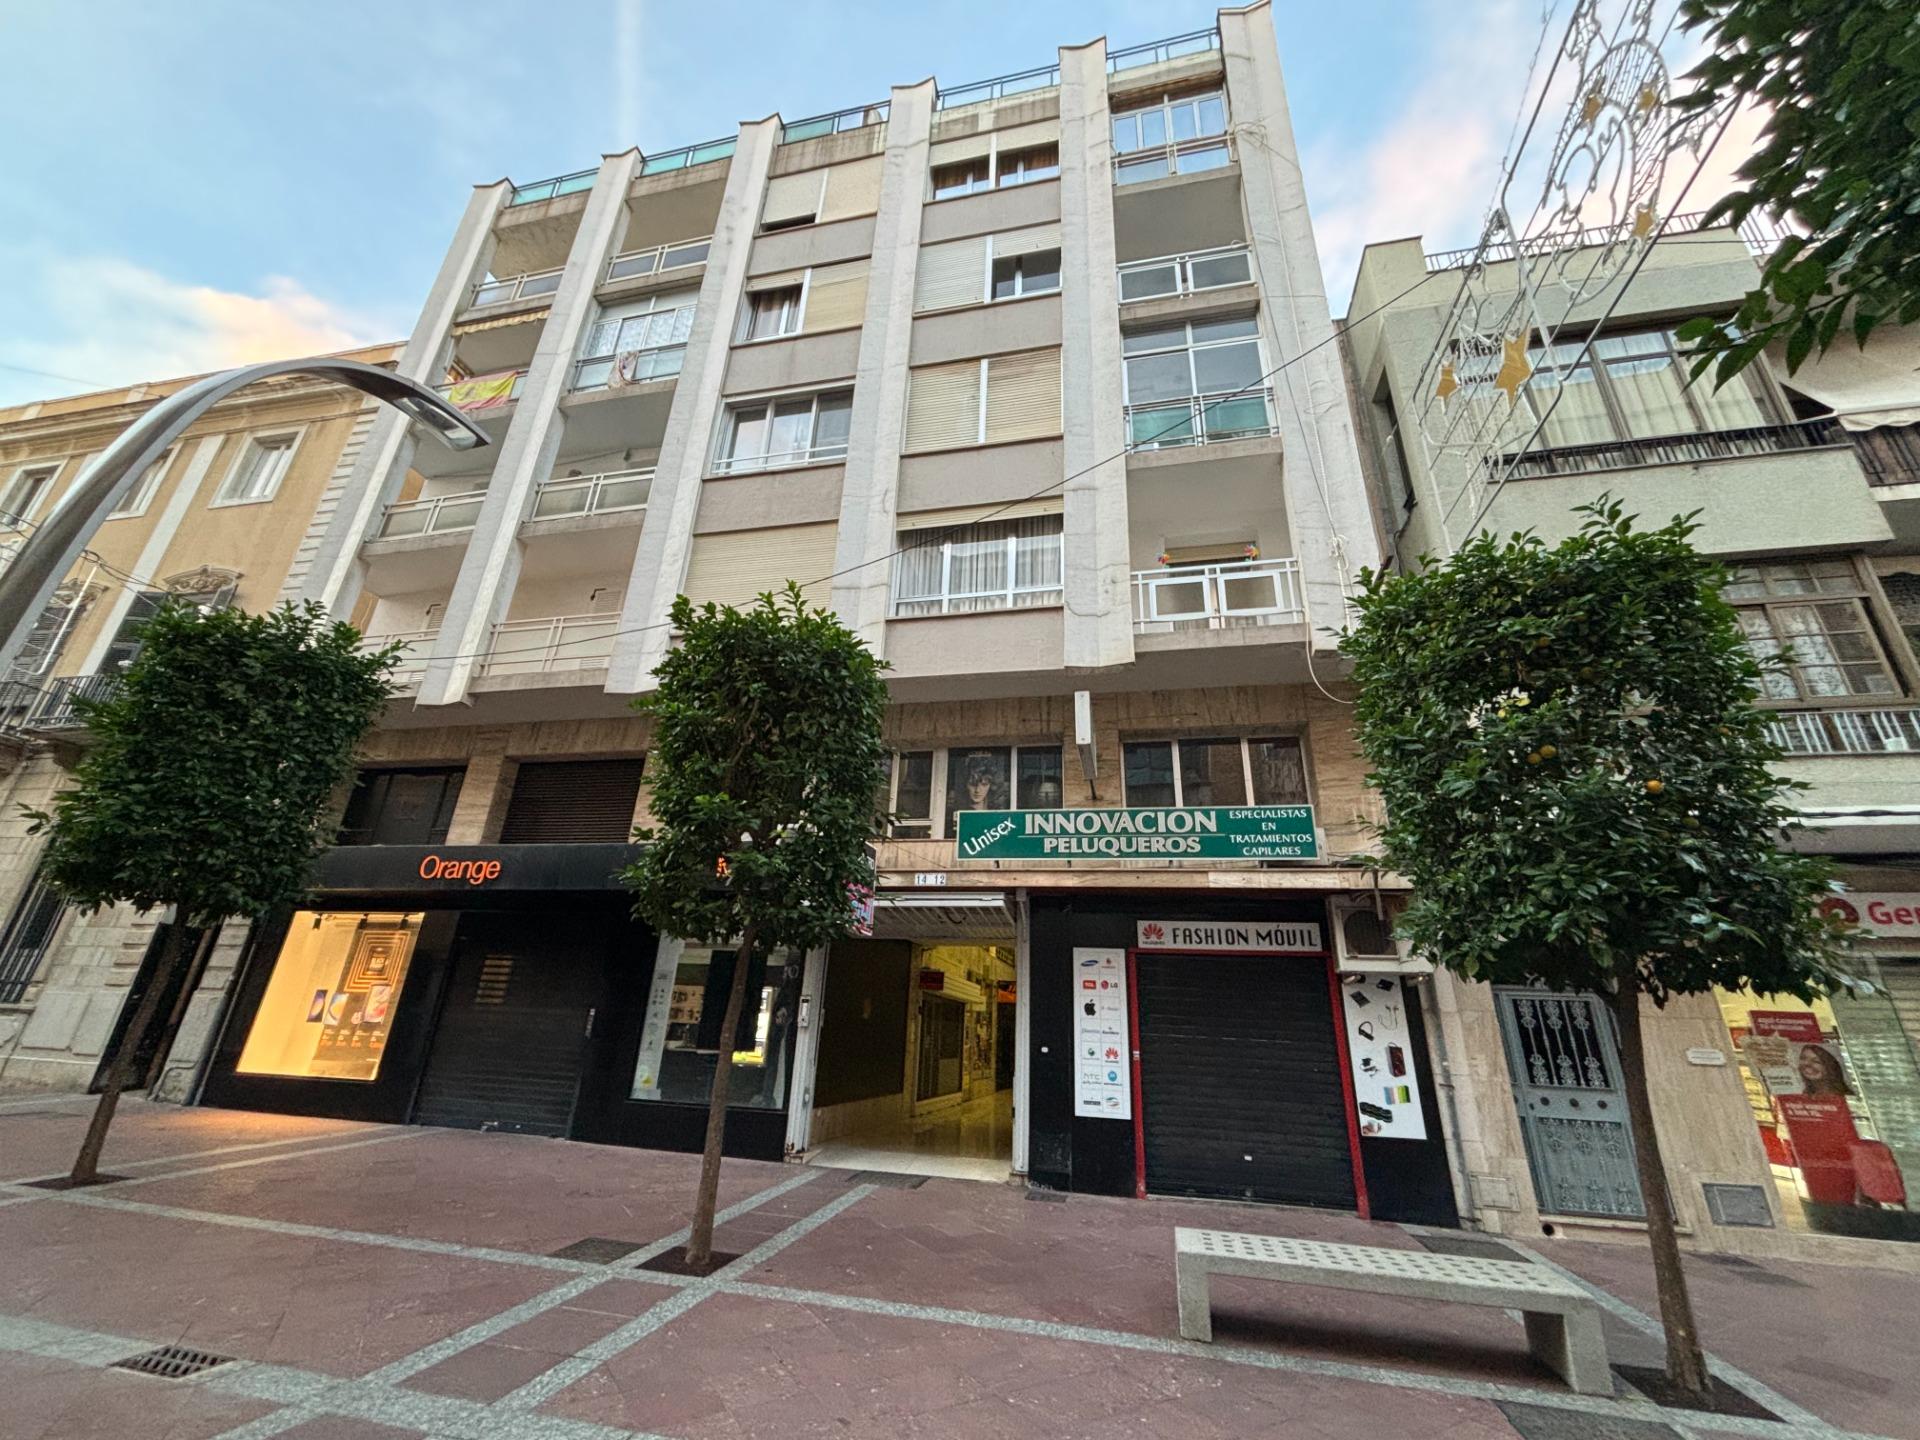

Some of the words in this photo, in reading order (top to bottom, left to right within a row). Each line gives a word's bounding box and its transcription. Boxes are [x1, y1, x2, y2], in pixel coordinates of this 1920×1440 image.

[1229, 809, 1307, 819] ESPECIALISTAS
[1024, 811, 1218, 835] INNOVACION
[1261, 822, 1277, 831] EN
[963, 817, 1016, 856] Unisex
[1229, 834, 1313, 844] TRATAMIENTOS
[1043, 836, 1201, 857] PELUQUEROS
[1242, 846, 1302, 856] CAPILARES
[419, 855, 501, 884] Orange
[916, 874, 927, 885] 14
[935, 874, 945, 885] 12
[1172, 927, 1250, 946] FASHION
